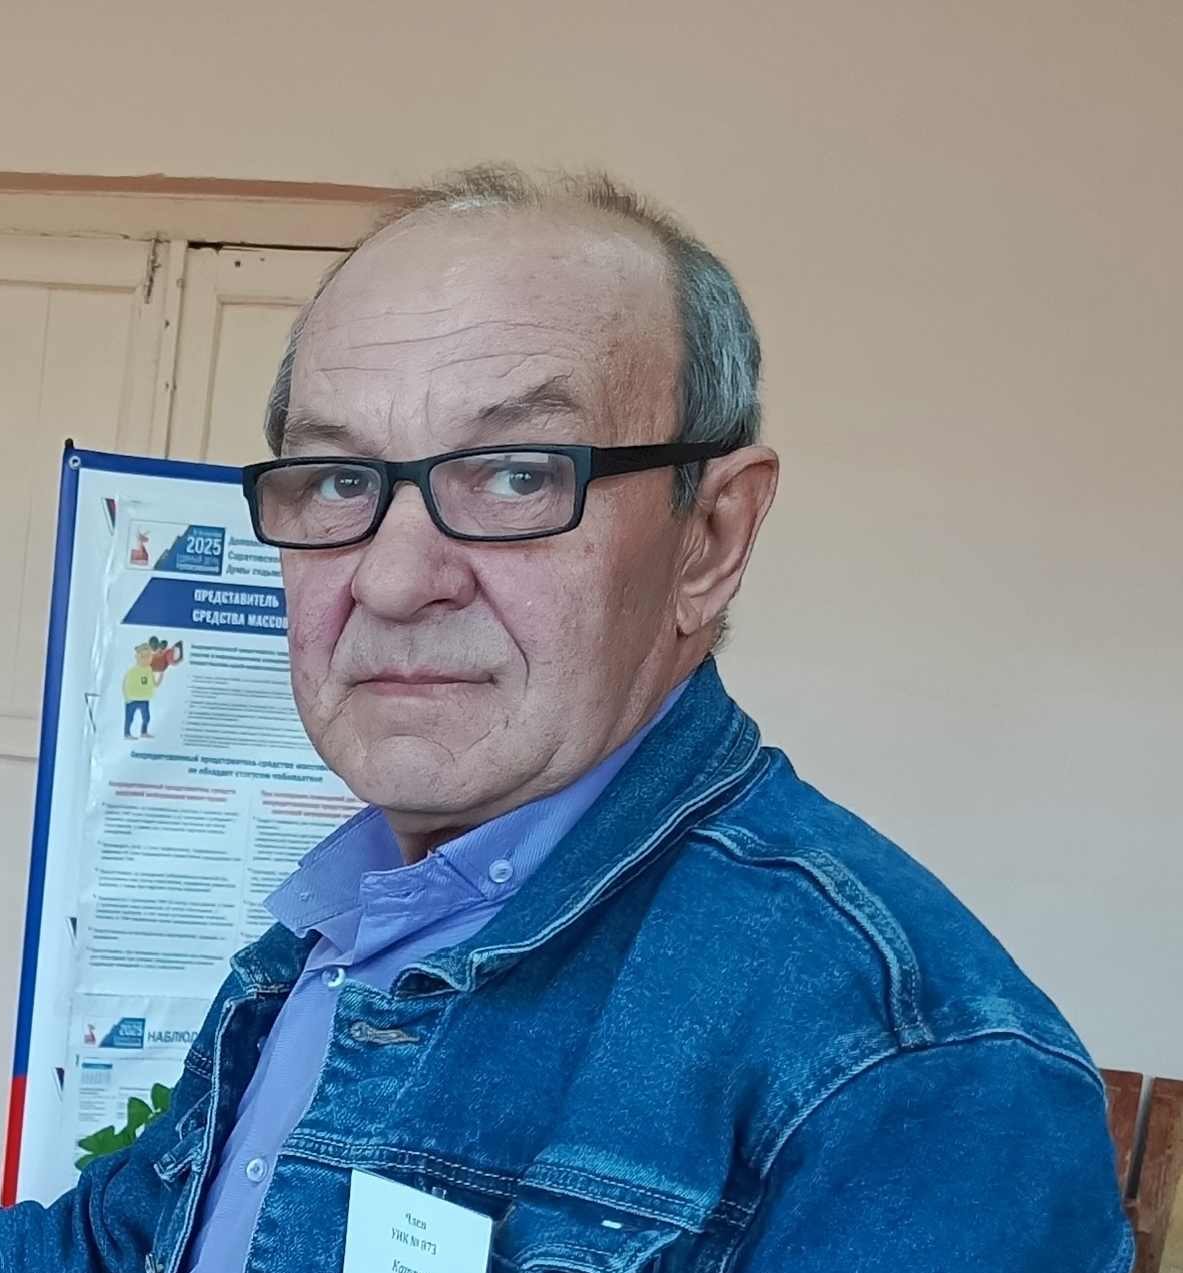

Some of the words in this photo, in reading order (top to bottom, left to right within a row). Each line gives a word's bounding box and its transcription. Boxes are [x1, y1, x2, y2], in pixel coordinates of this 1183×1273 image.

[185, 536, 222, 556] 2025
[194, 589, 280, 608] ПРЕДСТАВИТЕЛЬ
[192, 609, 245, 626] СРЕДСТВА
[405, 1213, 427, 1230] Член
[391, 1227, 409, 1245] УИК
[420, 1239, 437, 1255] 873
